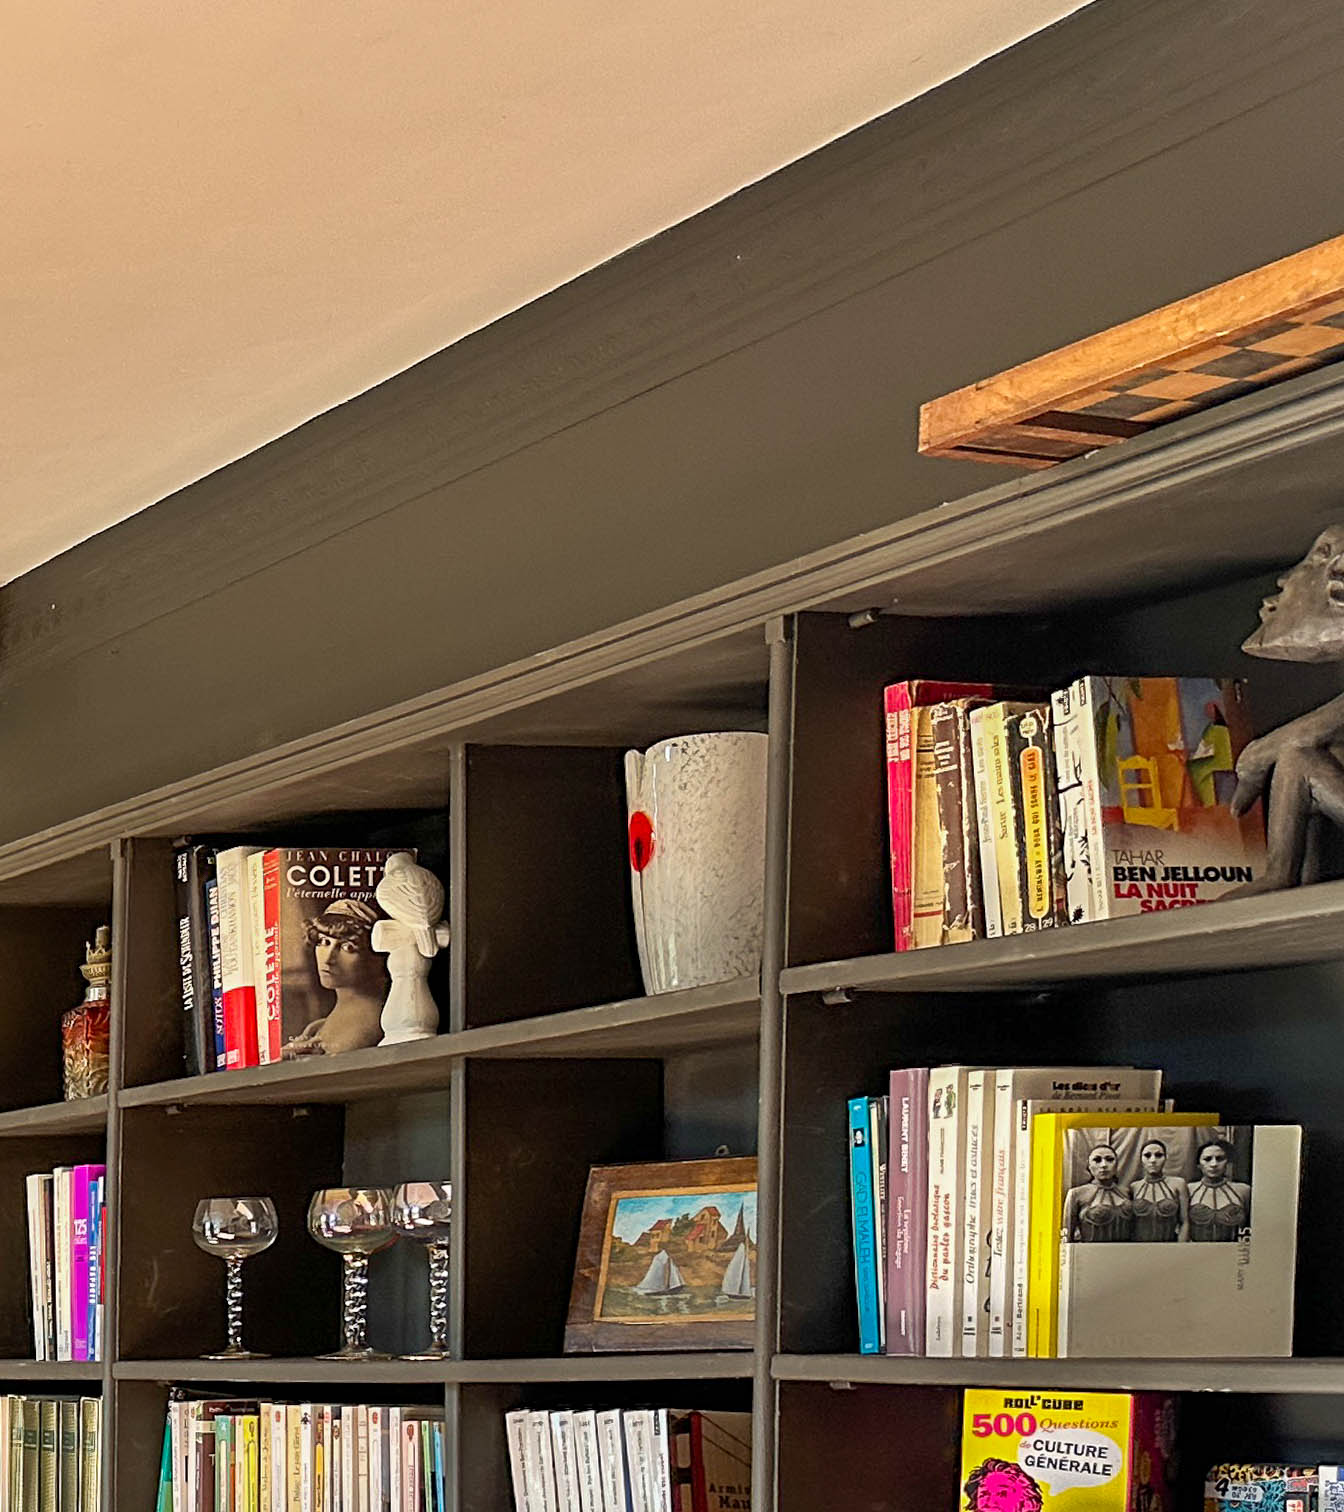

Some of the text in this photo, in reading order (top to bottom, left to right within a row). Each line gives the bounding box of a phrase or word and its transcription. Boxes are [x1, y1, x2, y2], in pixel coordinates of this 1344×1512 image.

[286, 850, 328, 862] JEAN
[1112, 850, 1165, 865] TAHAR
[1113, 866, 1253, 882] BEN JELLOUN
[1114, 883, 1199, 899] LA NUIT
[208, 886, 222, 989] PHILIPPE DJIAN
[264, 927, 276, 1020] COLETTE
[1052, 1080, 1072, 1091] Les
[900, 1096, 910, 1142] LAURENT
[972, 1412, 1119, 1438] 500 Questions
[1033, 1439, 1109, 1459] CULTURE
[1024, 1453, 1113, 1477] GÉNÉRALE
[1214, 1477, 1229, 1498] 4
